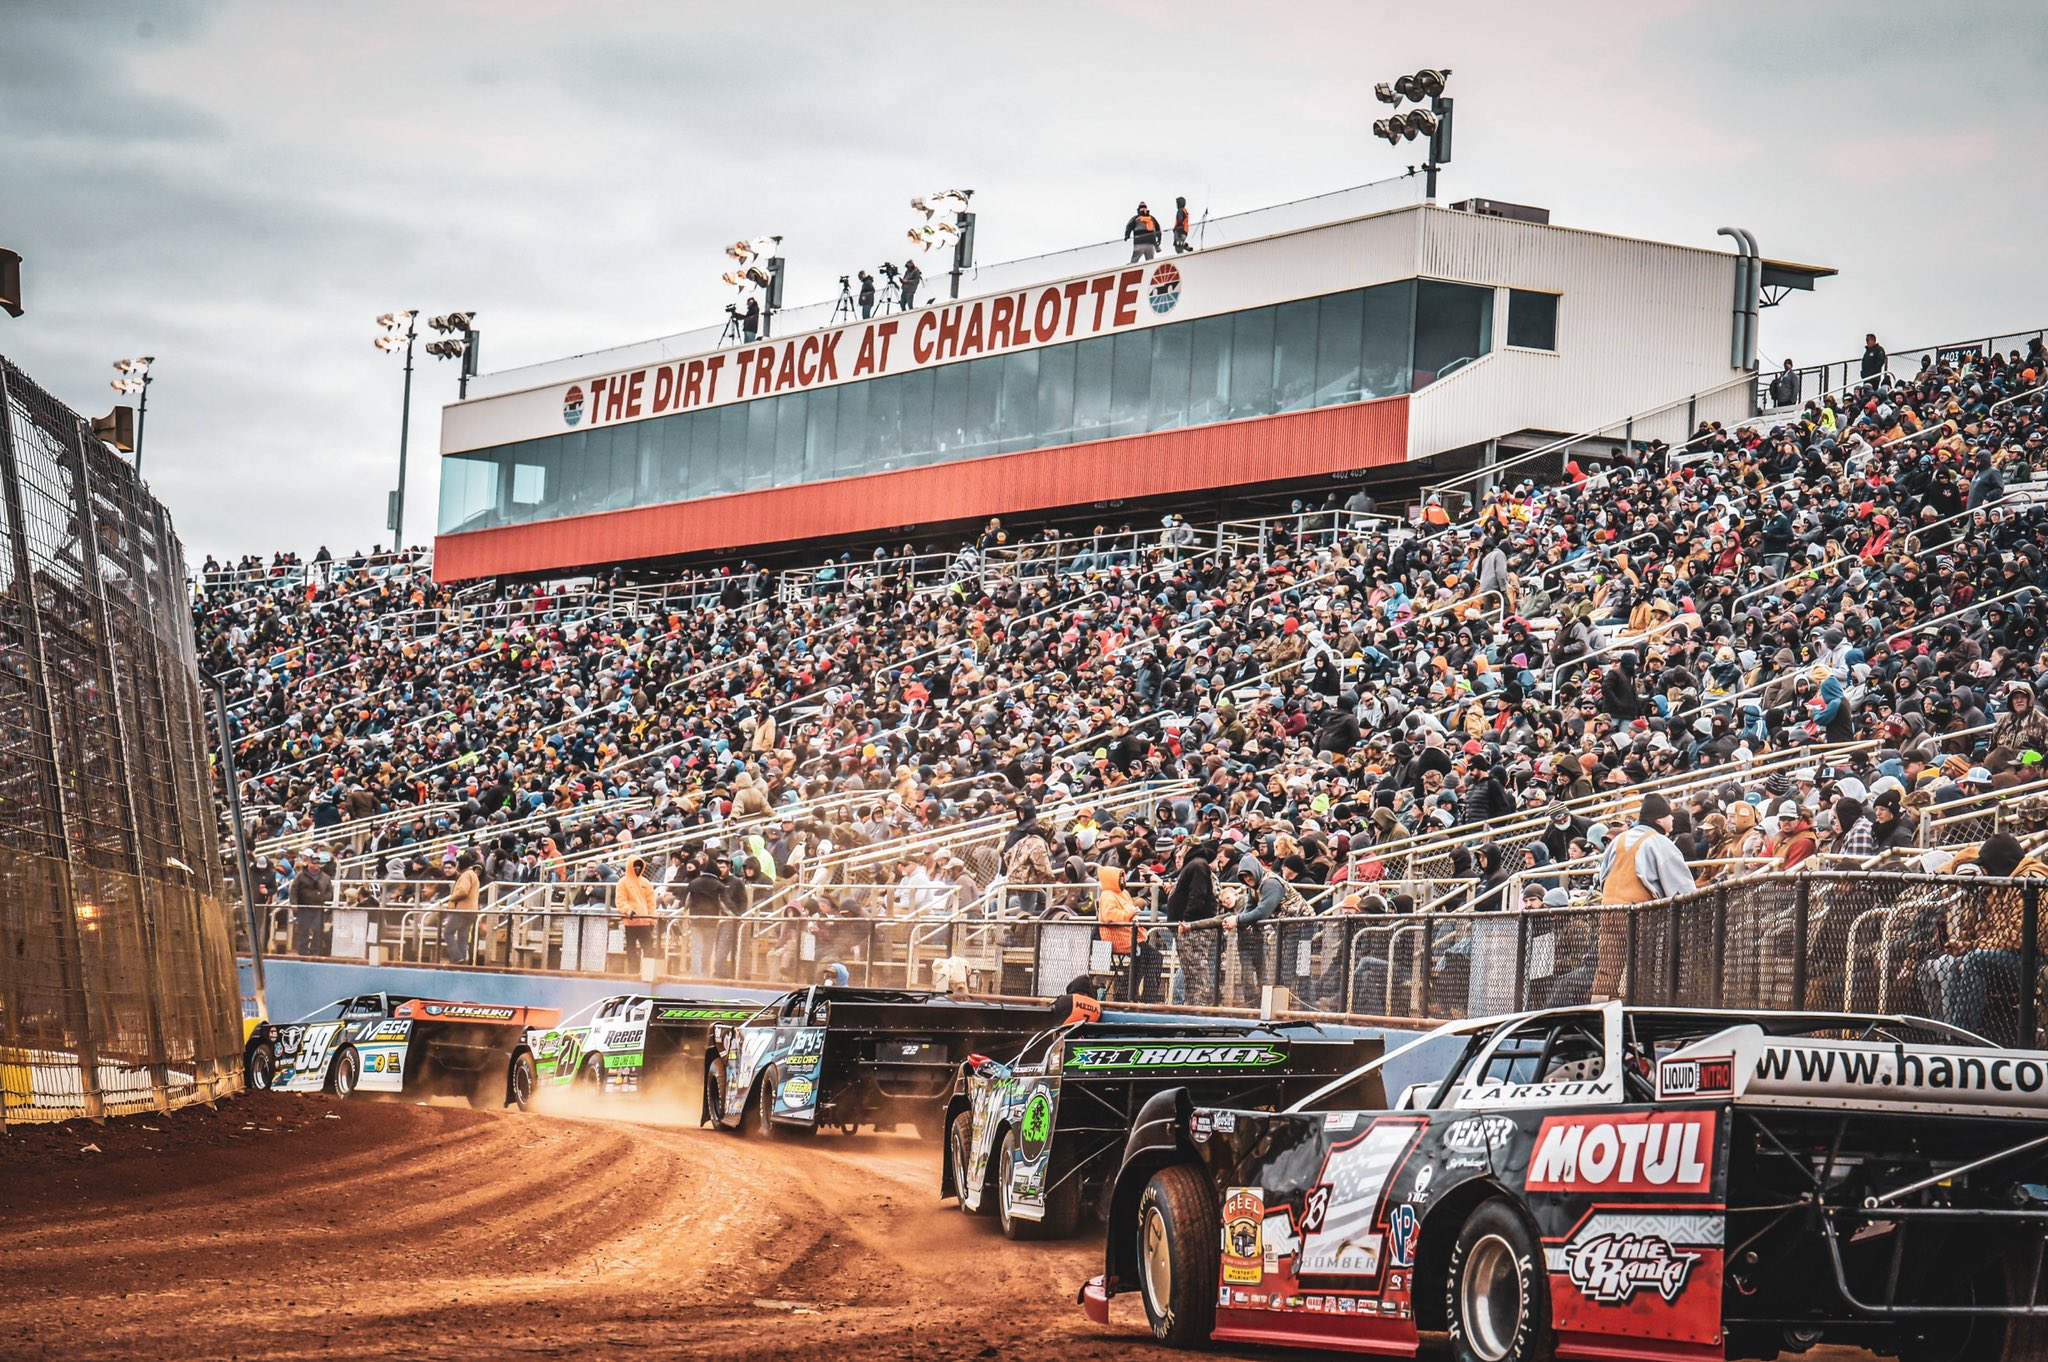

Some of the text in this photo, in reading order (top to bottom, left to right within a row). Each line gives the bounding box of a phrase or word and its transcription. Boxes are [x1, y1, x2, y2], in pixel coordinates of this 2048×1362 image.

[590, 268, 1144, 424] THE DIRT TRACK AT CHARLOTTE
[443, 1005, 513, 1017] LONGHORN
[1075, 1001, 1099, 1014] MEDIA
[354, 1020, 412, 1040] MEGA
[295, 1025, 341, 1072] 39
[902, 1046, 919, 1055] 22
[1136, 1047, 1269, 1065] ROCKET
[786, 1055, 819, 1065] USED CARS
[1756, 1044, 2048, 1093] www.hanco
[1664, 1066, 1695, 1090] LIQUID
[1700, 1064, 1730, 1089] NITRO
[1461, 1083, 1612, 1100] LARSON
[1528, 1123, 1705, 1184] MOTUL
[1229, 1194, 1260, 1215] REEL
[1391, 1204, 1415, 1265] VP
[1303, 1256, 1376, 1269] BOMBER
[1569, 1235, 1668, 1279] Arnie
[1588, 1256, 1684, 1294] Ranta
